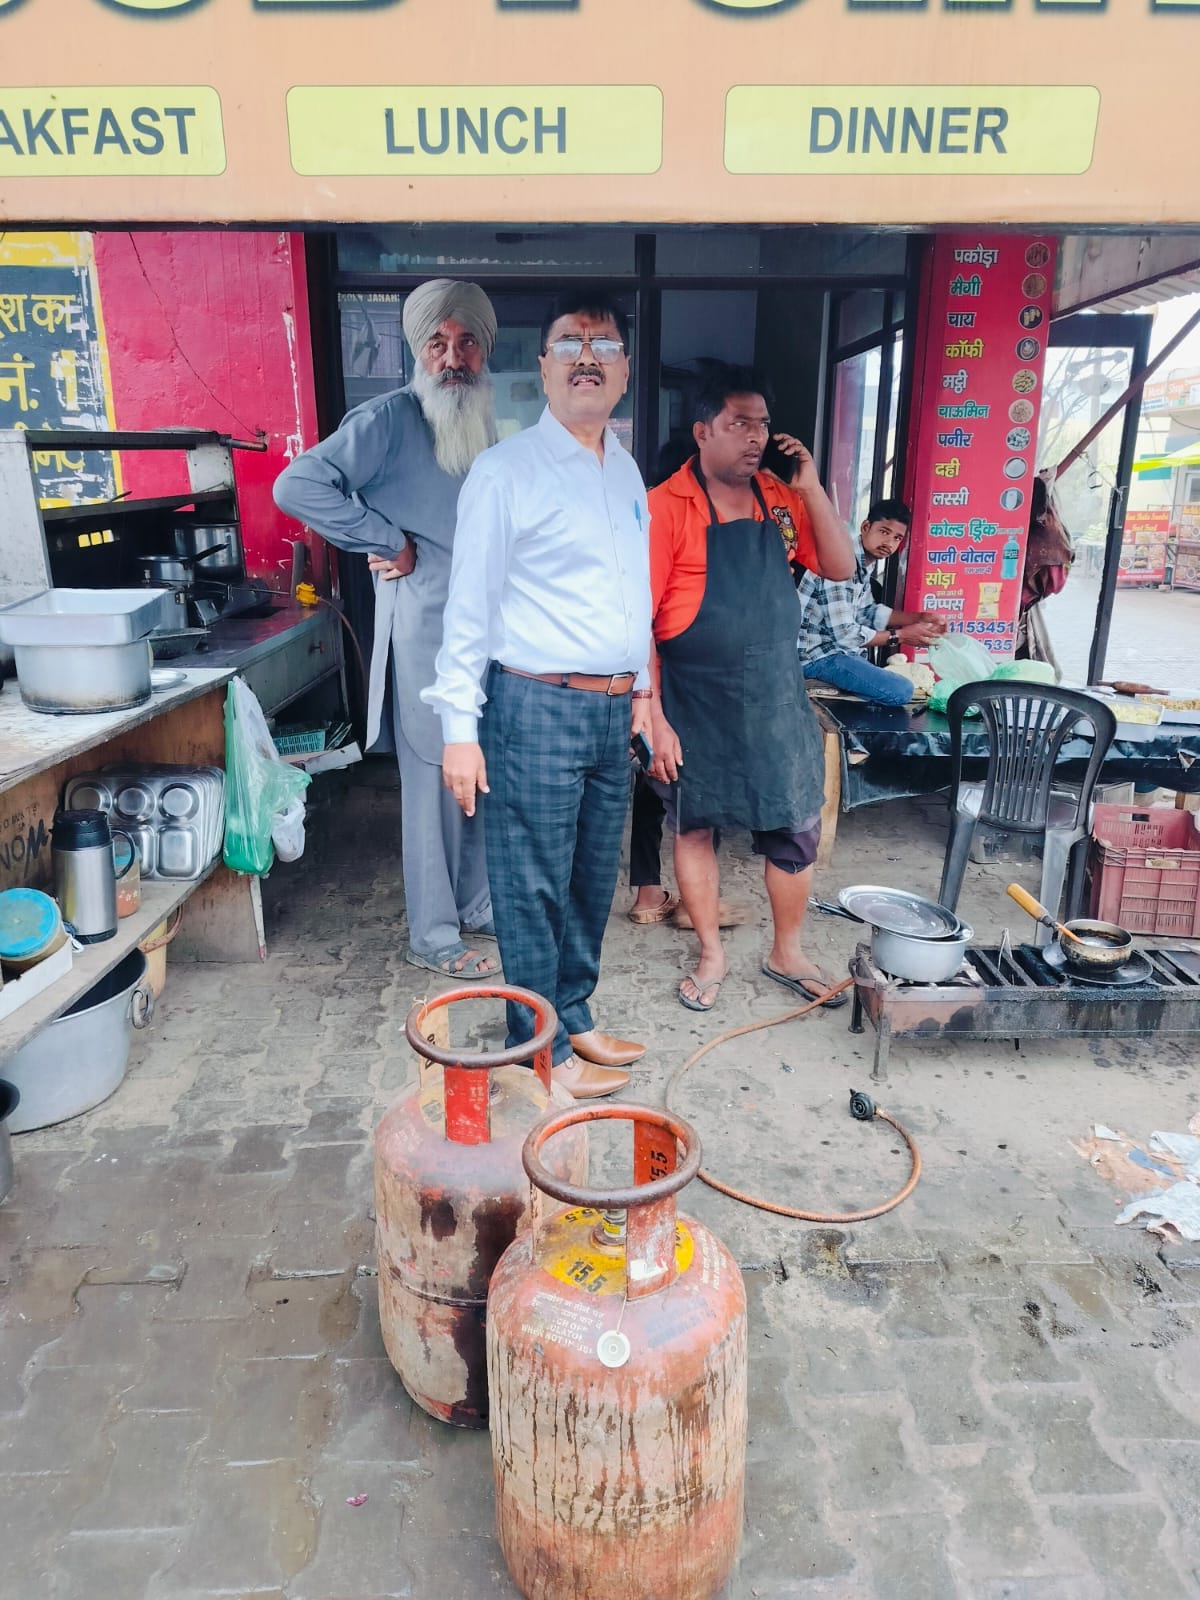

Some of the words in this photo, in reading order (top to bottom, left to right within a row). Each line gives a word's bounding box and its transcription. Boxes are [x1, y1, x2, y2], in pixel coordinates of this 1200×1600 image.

[0, 107, 195, 155] AKFAST
[385, 106, 567, 154] LUNCH
[809, 106, 1009, 154] DINNER
[947, 312, 976, 327] चाय
[945, 338, 984, 358] कॉफी
[937, 427, 974, 447] पनीर
[935, 457, 960, 477] दही
[932, 486, 969, 505] लस्सी
[929, 519, 966, 538] कोल्ड
[927, 545, 957, 564] पानी
[949, 621, 1015, 633] 4153451
[566, 1259, 608, 1293] 15.5
